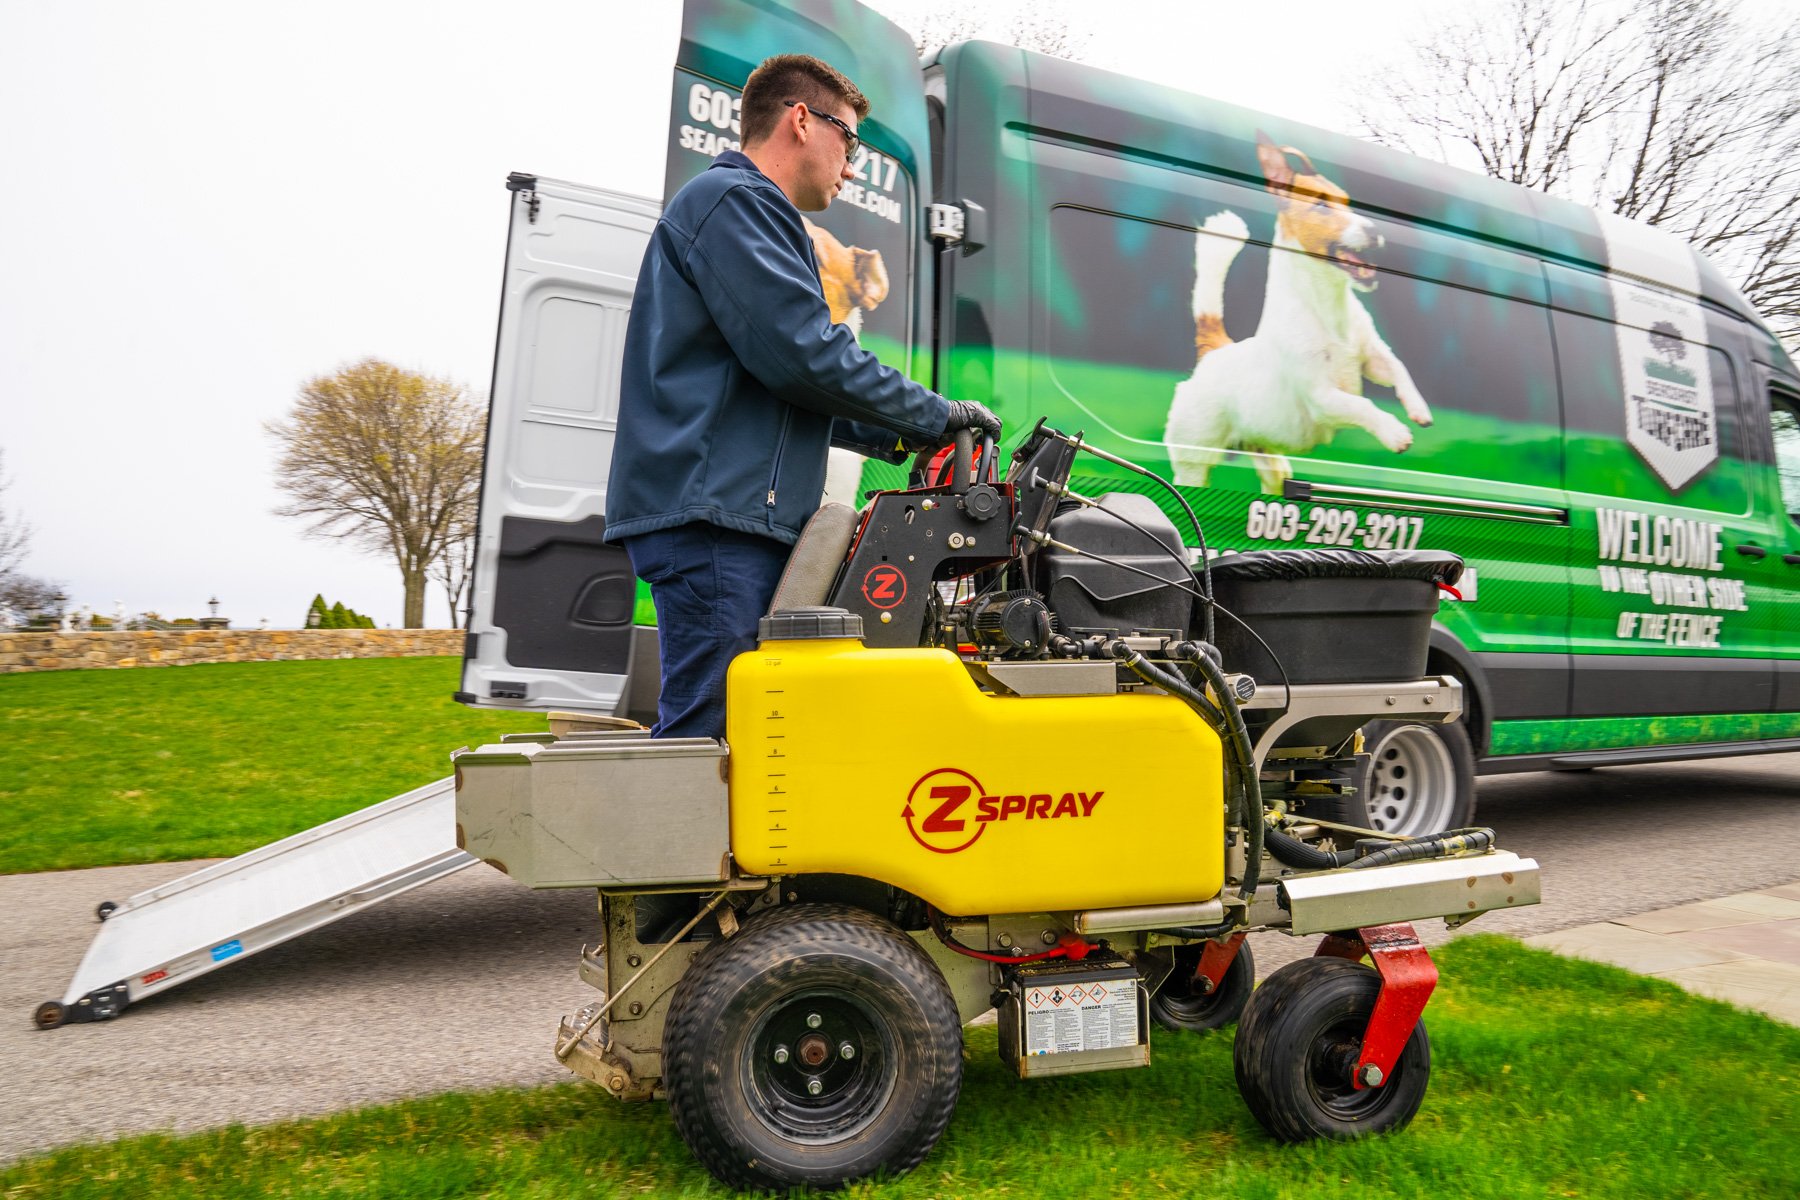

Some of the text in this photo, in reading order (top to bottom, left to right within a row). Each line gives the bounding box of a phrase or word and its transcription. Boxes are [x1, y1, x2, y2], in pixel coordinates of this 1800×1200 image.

[1246, 500, 1425, 550] 603-292-3217
[1596, 507, 1724, 571] WELCOME
[1619, 567, 1650, 594] THE
[1649, 571, 1709, 608] OTHER
[1706, 577, 1749, 611] SIDE
[1616, 611, 1724, 648] OF THE FENCE
[975, 791, 1105, 822] SPRAY
